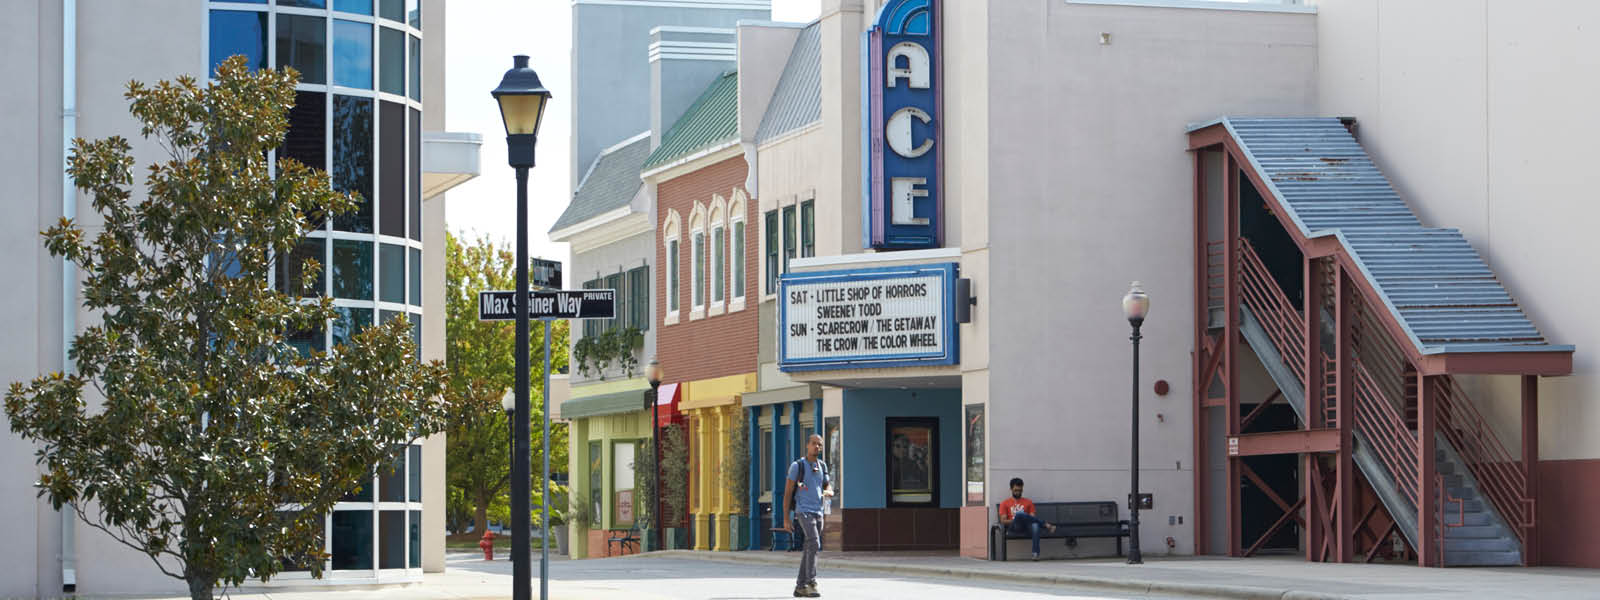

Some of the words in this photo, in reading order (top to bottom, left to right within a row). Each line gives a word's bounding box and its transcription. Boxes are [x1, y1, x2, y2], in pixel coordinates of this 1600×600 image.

[886, 41, 935, 226] ACE
[583, 292, 612, 300] PRIVATE
[790, 291, 807, 304] SAT
[816, 289, 845, 303] LITTLE
[847, 287, 870, 301] SHOP
[872, 286, 882, 300] OF
[885, 283, 927, 299] HORRORS
[483, 293, 509, 314] Max
[557, 293, 582, 318] Way
[817, 304, 856, 319] SWEENEY
[858, 303, 882, 317] TODD
[790, 323, 807, 337] SUN
[817, 320, 869, 335] SCARECROW
[876, 319, 892, 332] THE
[894, 316, 936, 332] GETAWAY
[816, 338, 832, 352] THE
[833, 337, 858, 351] CROW
[863, 336, 878, 350] THE
[880, 335, 907, 349] COLOR
[909, 333, 937, 347] WHEEL
